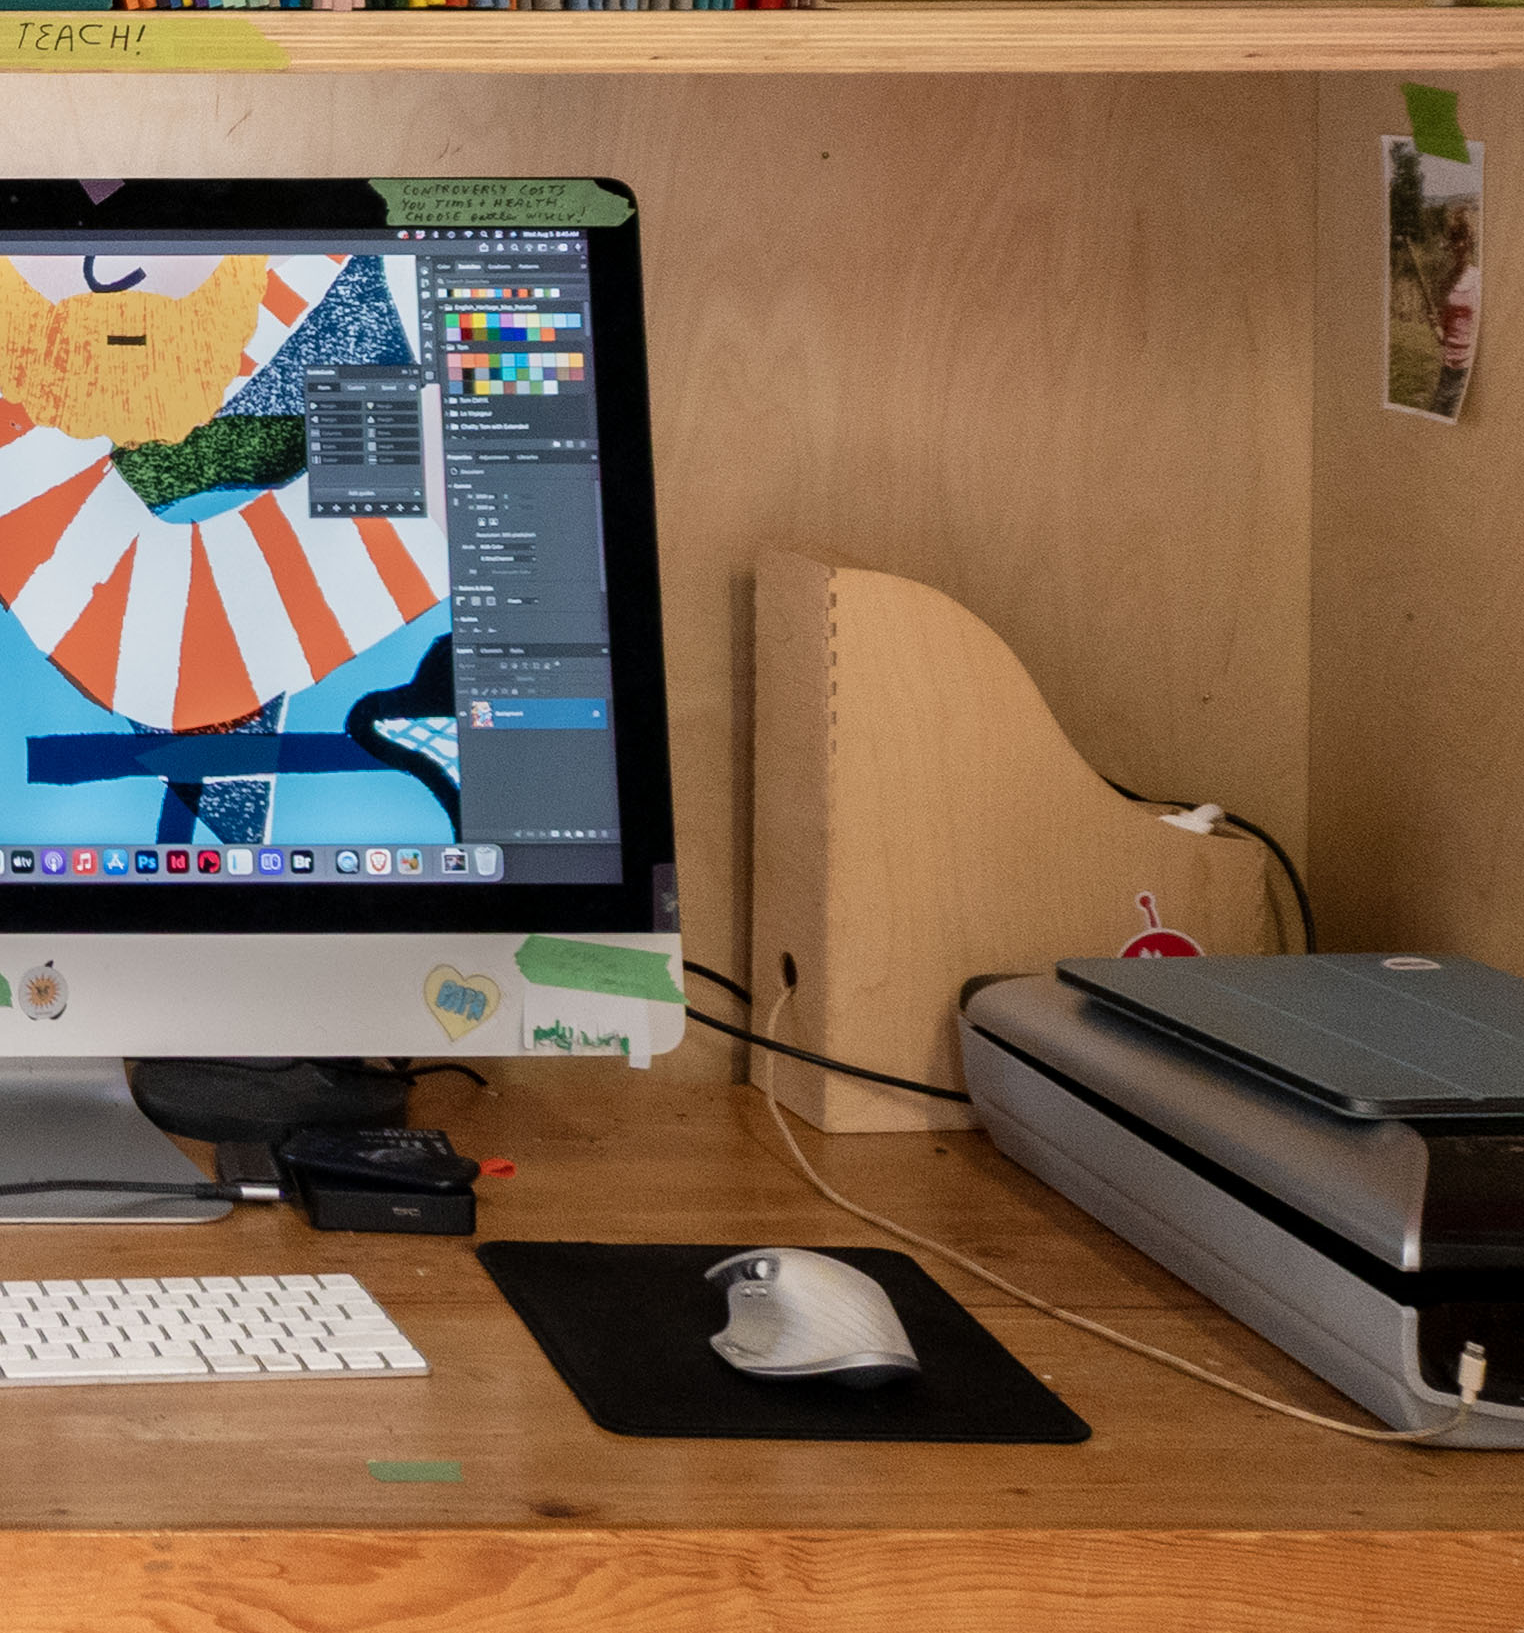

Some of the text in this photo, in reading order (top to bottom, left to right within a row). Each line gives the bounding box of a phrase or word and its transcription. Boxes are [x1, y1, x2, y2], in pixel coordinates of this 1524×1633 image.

[18, 23, 147, 56] TEACH!
[403, 184, 566, 196] CONTROVERSY COSTS
[402, 199, 426, 210] YOU
[435, 199, 473, 209] TIME
[405, 211, 460, 222] CHOOSE
[137, 856, 157, 870] Ps
[172, 856, 185, 870] Id
[294, 856, 312, 869] Br
